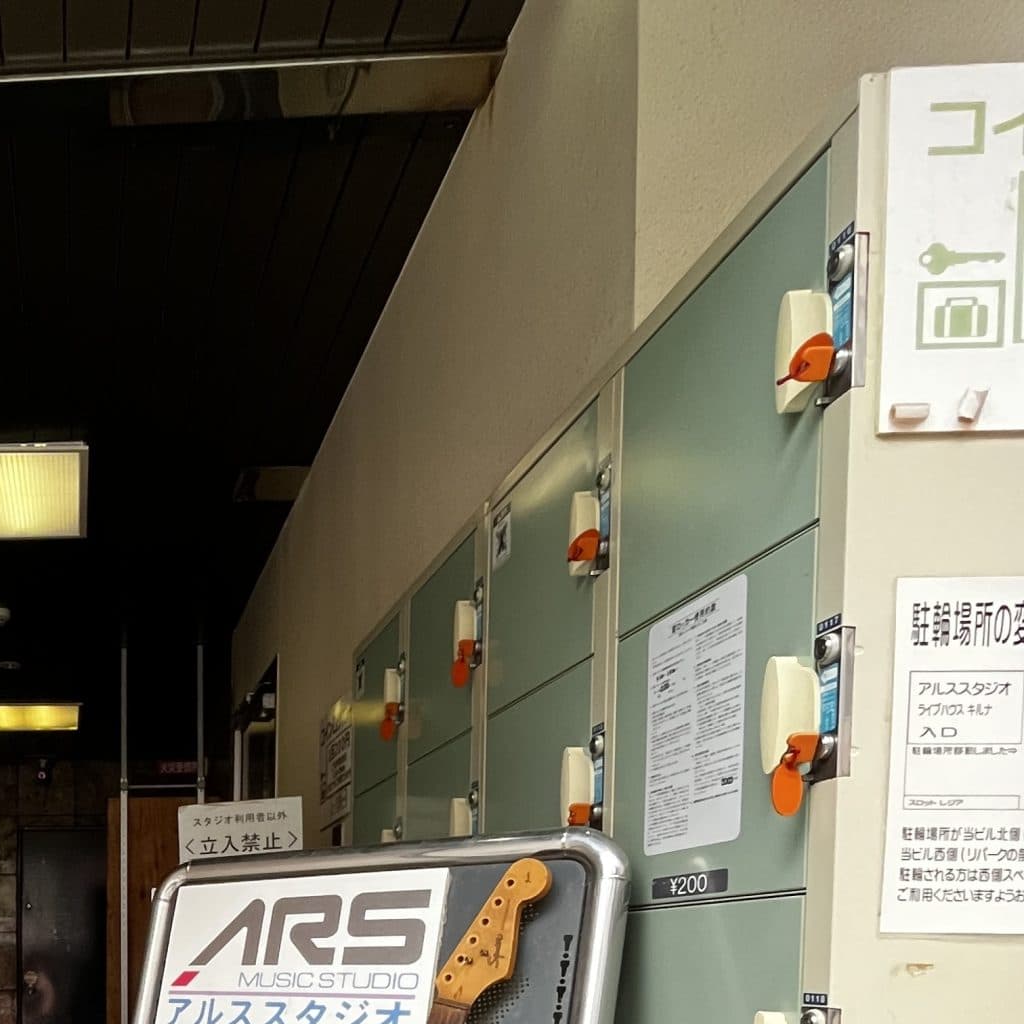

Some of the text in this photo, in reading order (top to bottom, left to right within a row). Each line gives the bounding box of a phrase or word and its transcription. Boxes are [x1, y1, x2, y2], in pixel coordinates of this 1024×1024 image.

[917, 681, 1012, 696] アルススタジオ
[919, 726, 958, 739] 入口
[669, 872, 708, 897] ¥200
[188, 889, 432, 967] ARS
[237, 970, 420, 991] MUSIC STUDIO
